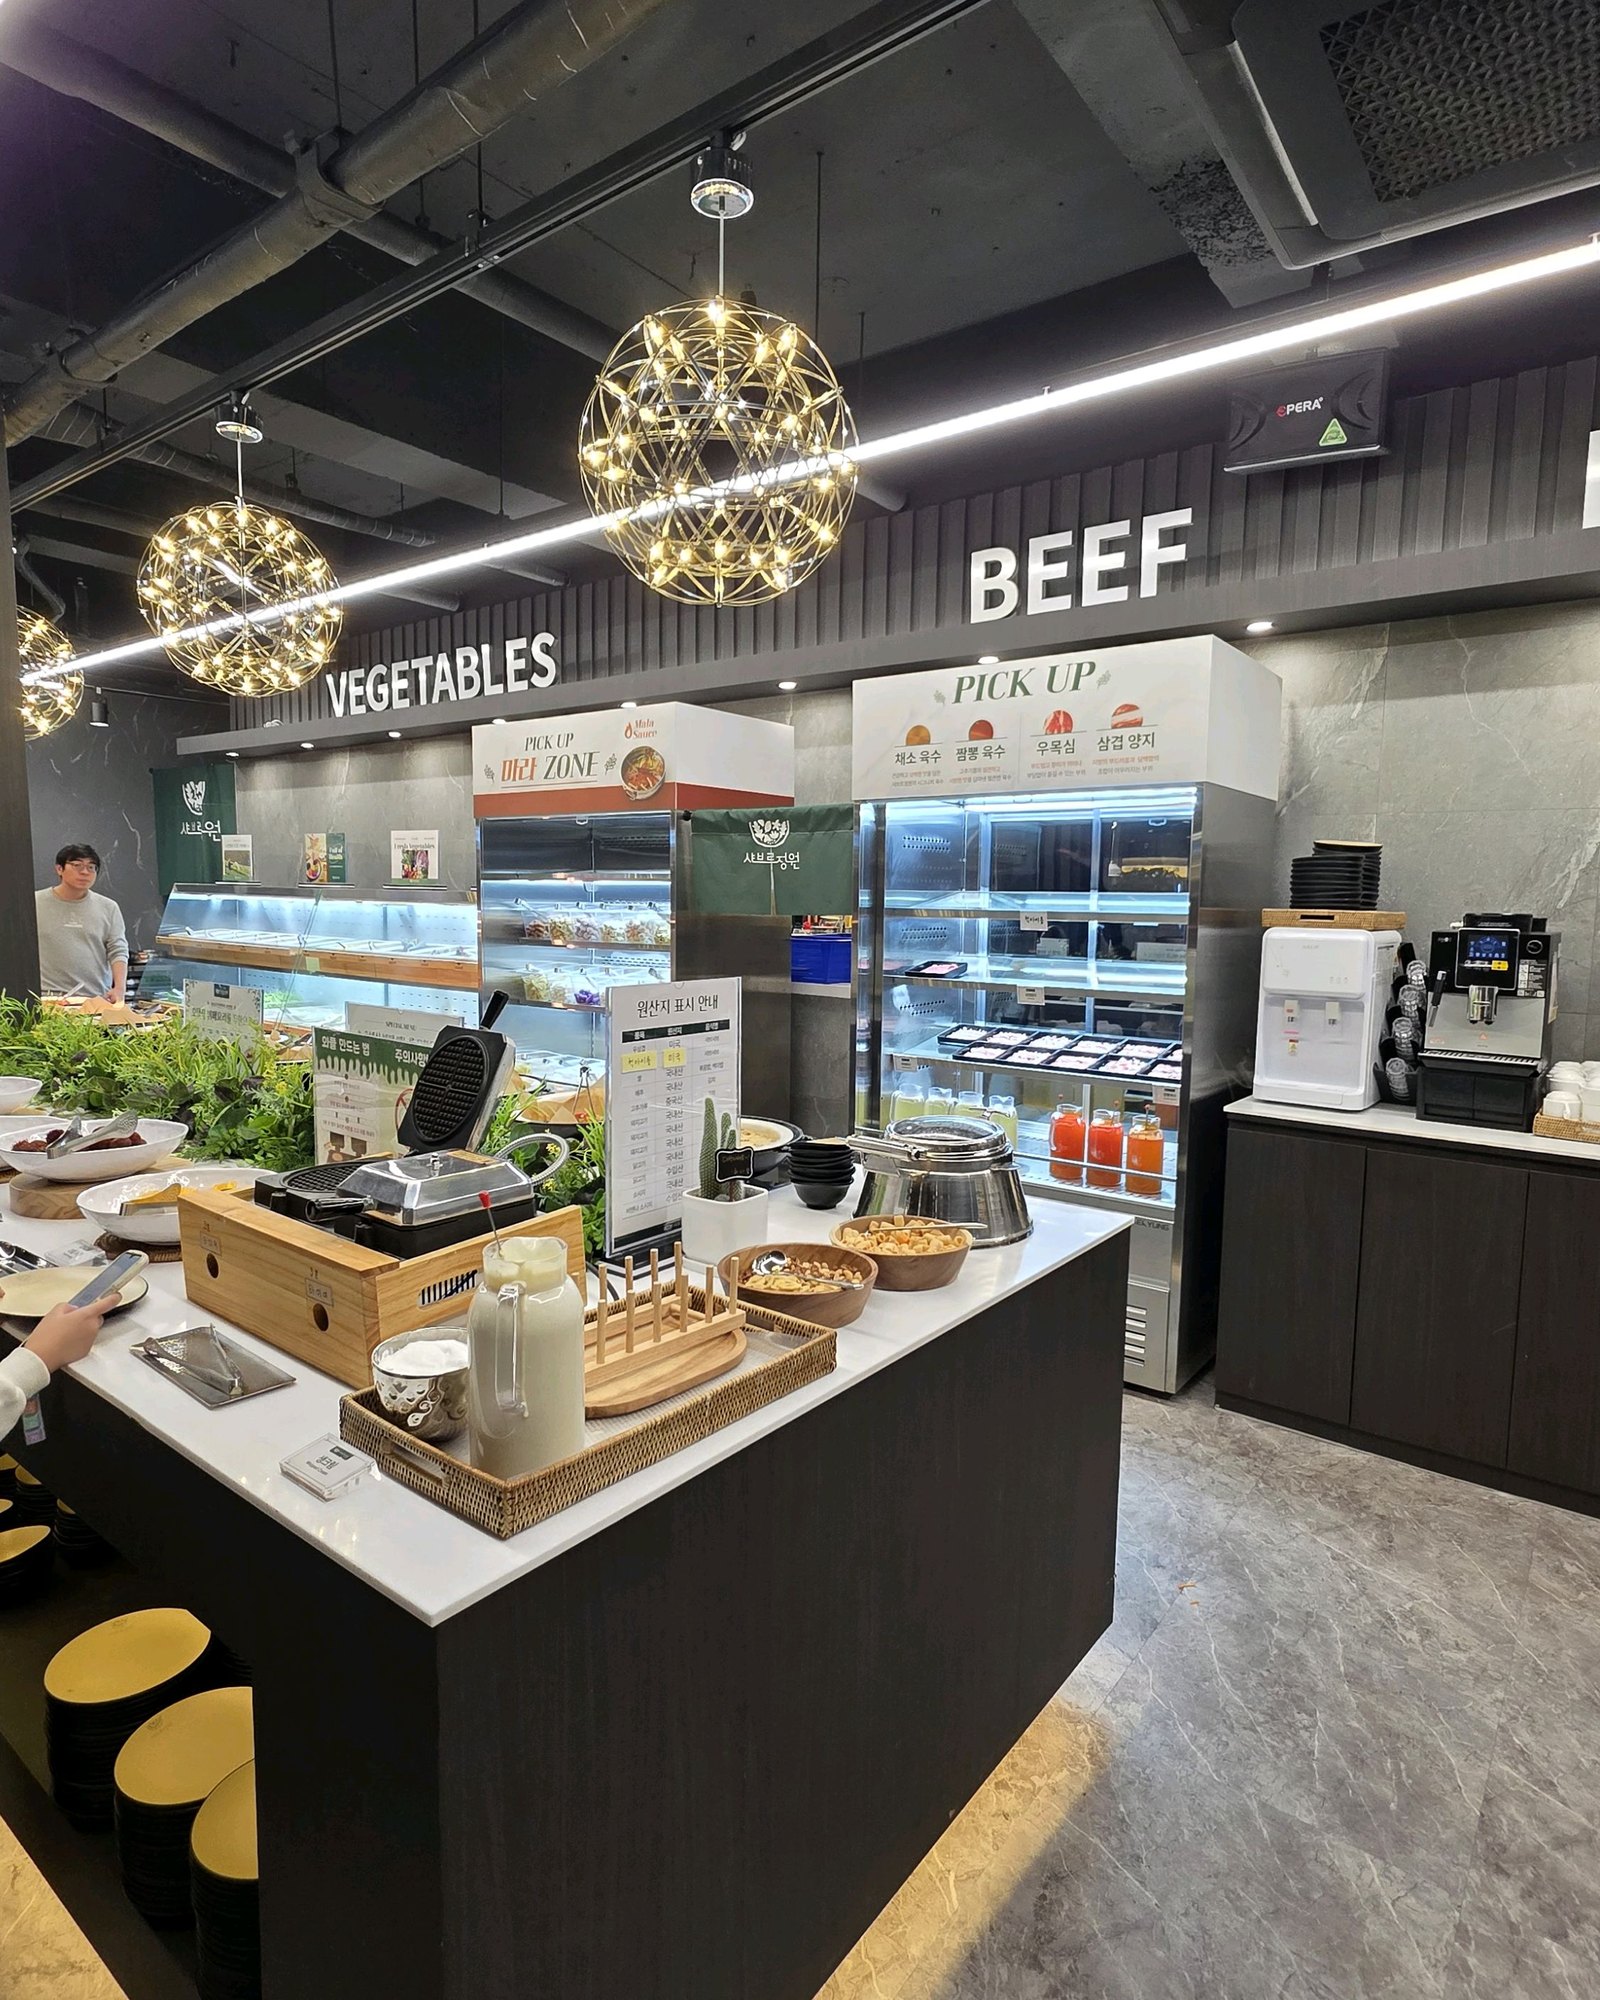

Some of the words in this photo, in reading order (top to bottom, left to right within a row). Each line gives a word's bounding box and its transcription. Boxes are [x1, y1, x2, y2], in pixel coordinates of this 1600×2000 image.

[970, 507, 1193, 624] BEEF
[325, 632, 559, 718] VEGETABLES
[952, 667, 1036, 704] PICK
[1047, 661, 1096, 693] UP
[634, 719, 654, 729] Mala
[633, 729, 657, 739] Sauce
[525, 735, 553, 751] PICK
[556, 733, 574, 749] UP
[1036, 738, 1075, 756] 우목심
[1097, 734, 1123, 752] 삼겹
[1128, 732, 1155, 749] 양지
[894, 751, 916, 766] 채소
[919, 749, 942, 764] 육수
[956, 746, 979, 762] 짬뽕
[982, 744, 1006, 760] 육수
[501, 757, 537, 782] 마라
[543, 751, 600, 780] ZONE
[637, 998, 670, 1018] 원산지
[674, 996, 695, 1012] 표시
[698, 995, 718, 1011] 안내
[322, 1035, 336, 1050] 와플
[339, 1038, 360, 1055] 만드는
[669, 1039, 681, 1048] 미국
[665, 1068, 683, 1078] 국내산
[665, 1081, 683, 1092] 국내산
[665, 1095, 683, 1106] 중국산
[665, 1109, 683, 1120] 국내산
[665, 1122, 683, 1133] 국내산
[665, 1137, 683, 1147] 국내산
[665, 1150, 683, 1161] 국내산
[666, 1164, 683, 1176] 수입산
[665, 1177, 683, 1189] 국내산
[316, 1455, 339, 1470] 생크림
